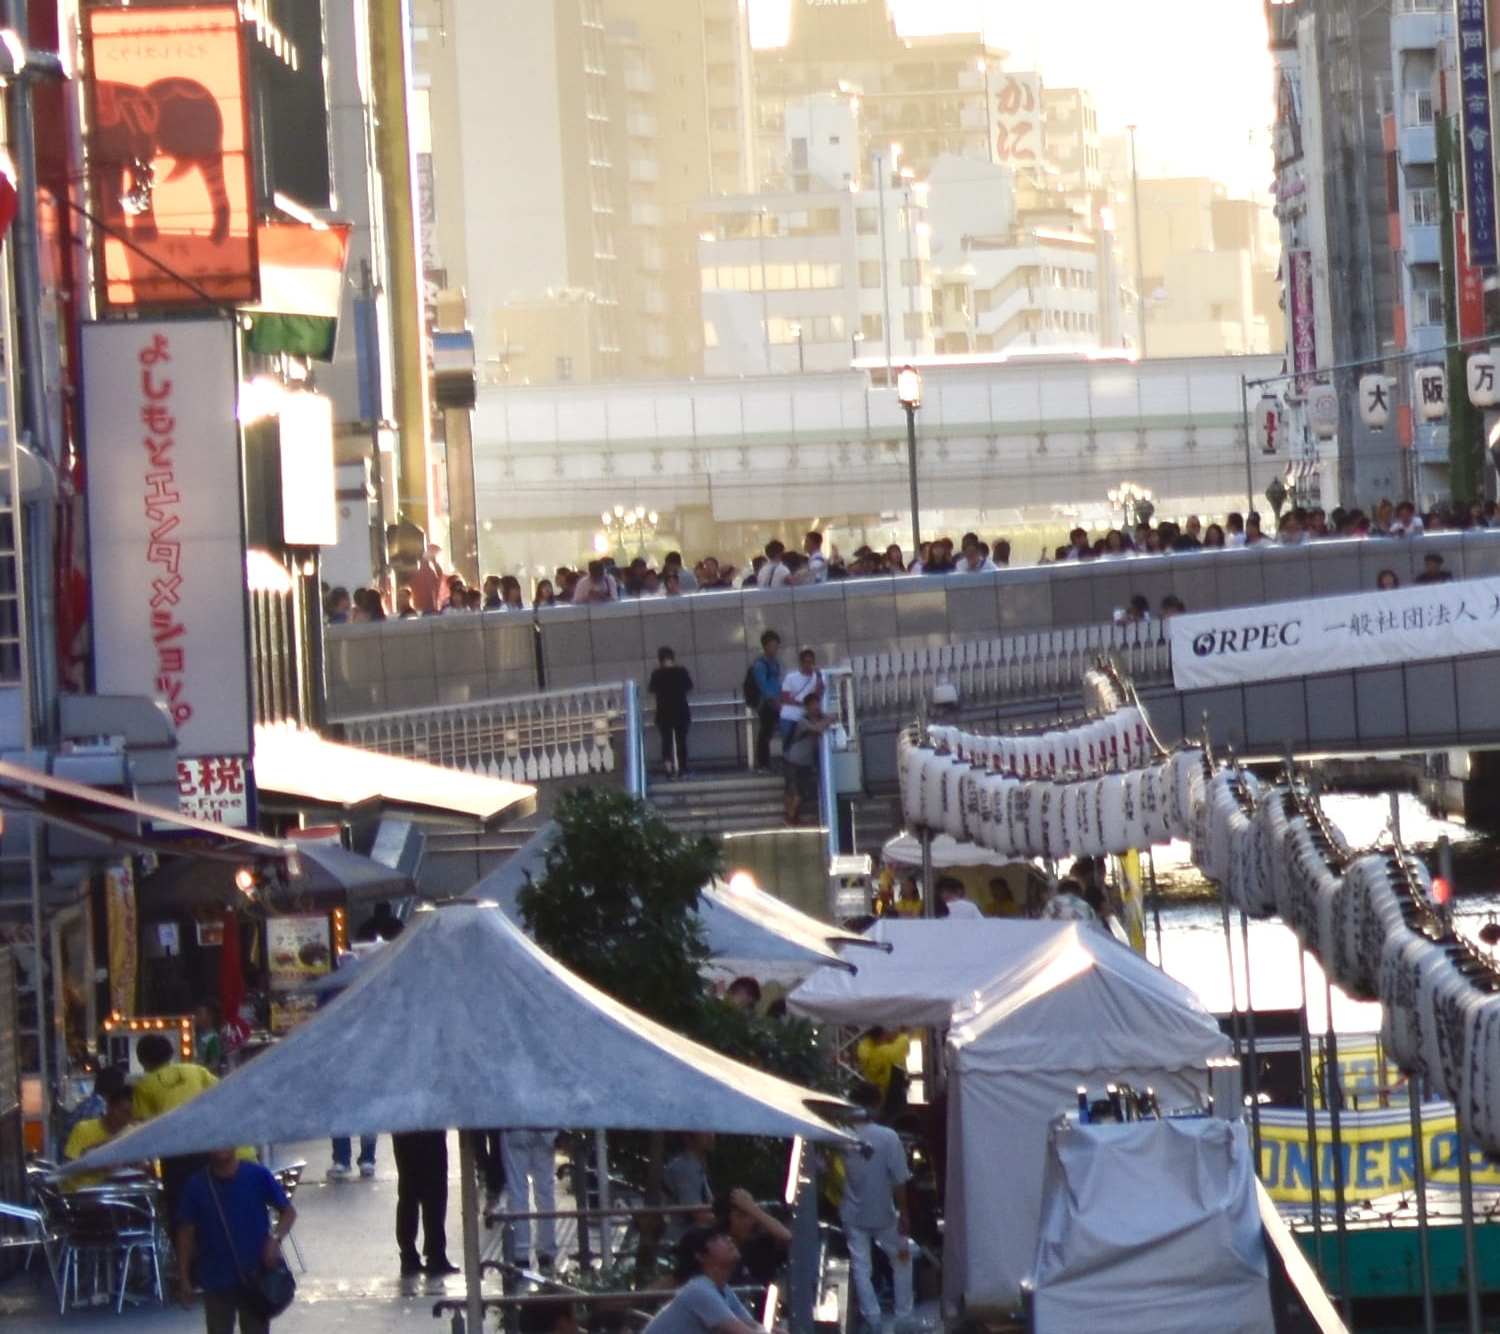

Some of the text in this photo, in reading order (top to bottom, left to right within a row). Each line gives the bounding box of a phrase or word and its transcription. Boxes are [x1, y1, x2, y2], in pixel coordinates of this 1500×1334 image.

[995, 75, 1037, 161] かに
[1473, 160, 1490, 243] OKAMOTO
[137, 332, 192, 729] よしもとエンタメショップ
[1191, 618, 1302, 659] ORPEC
[1322, 603, 1479, 637] 一般社団法人
